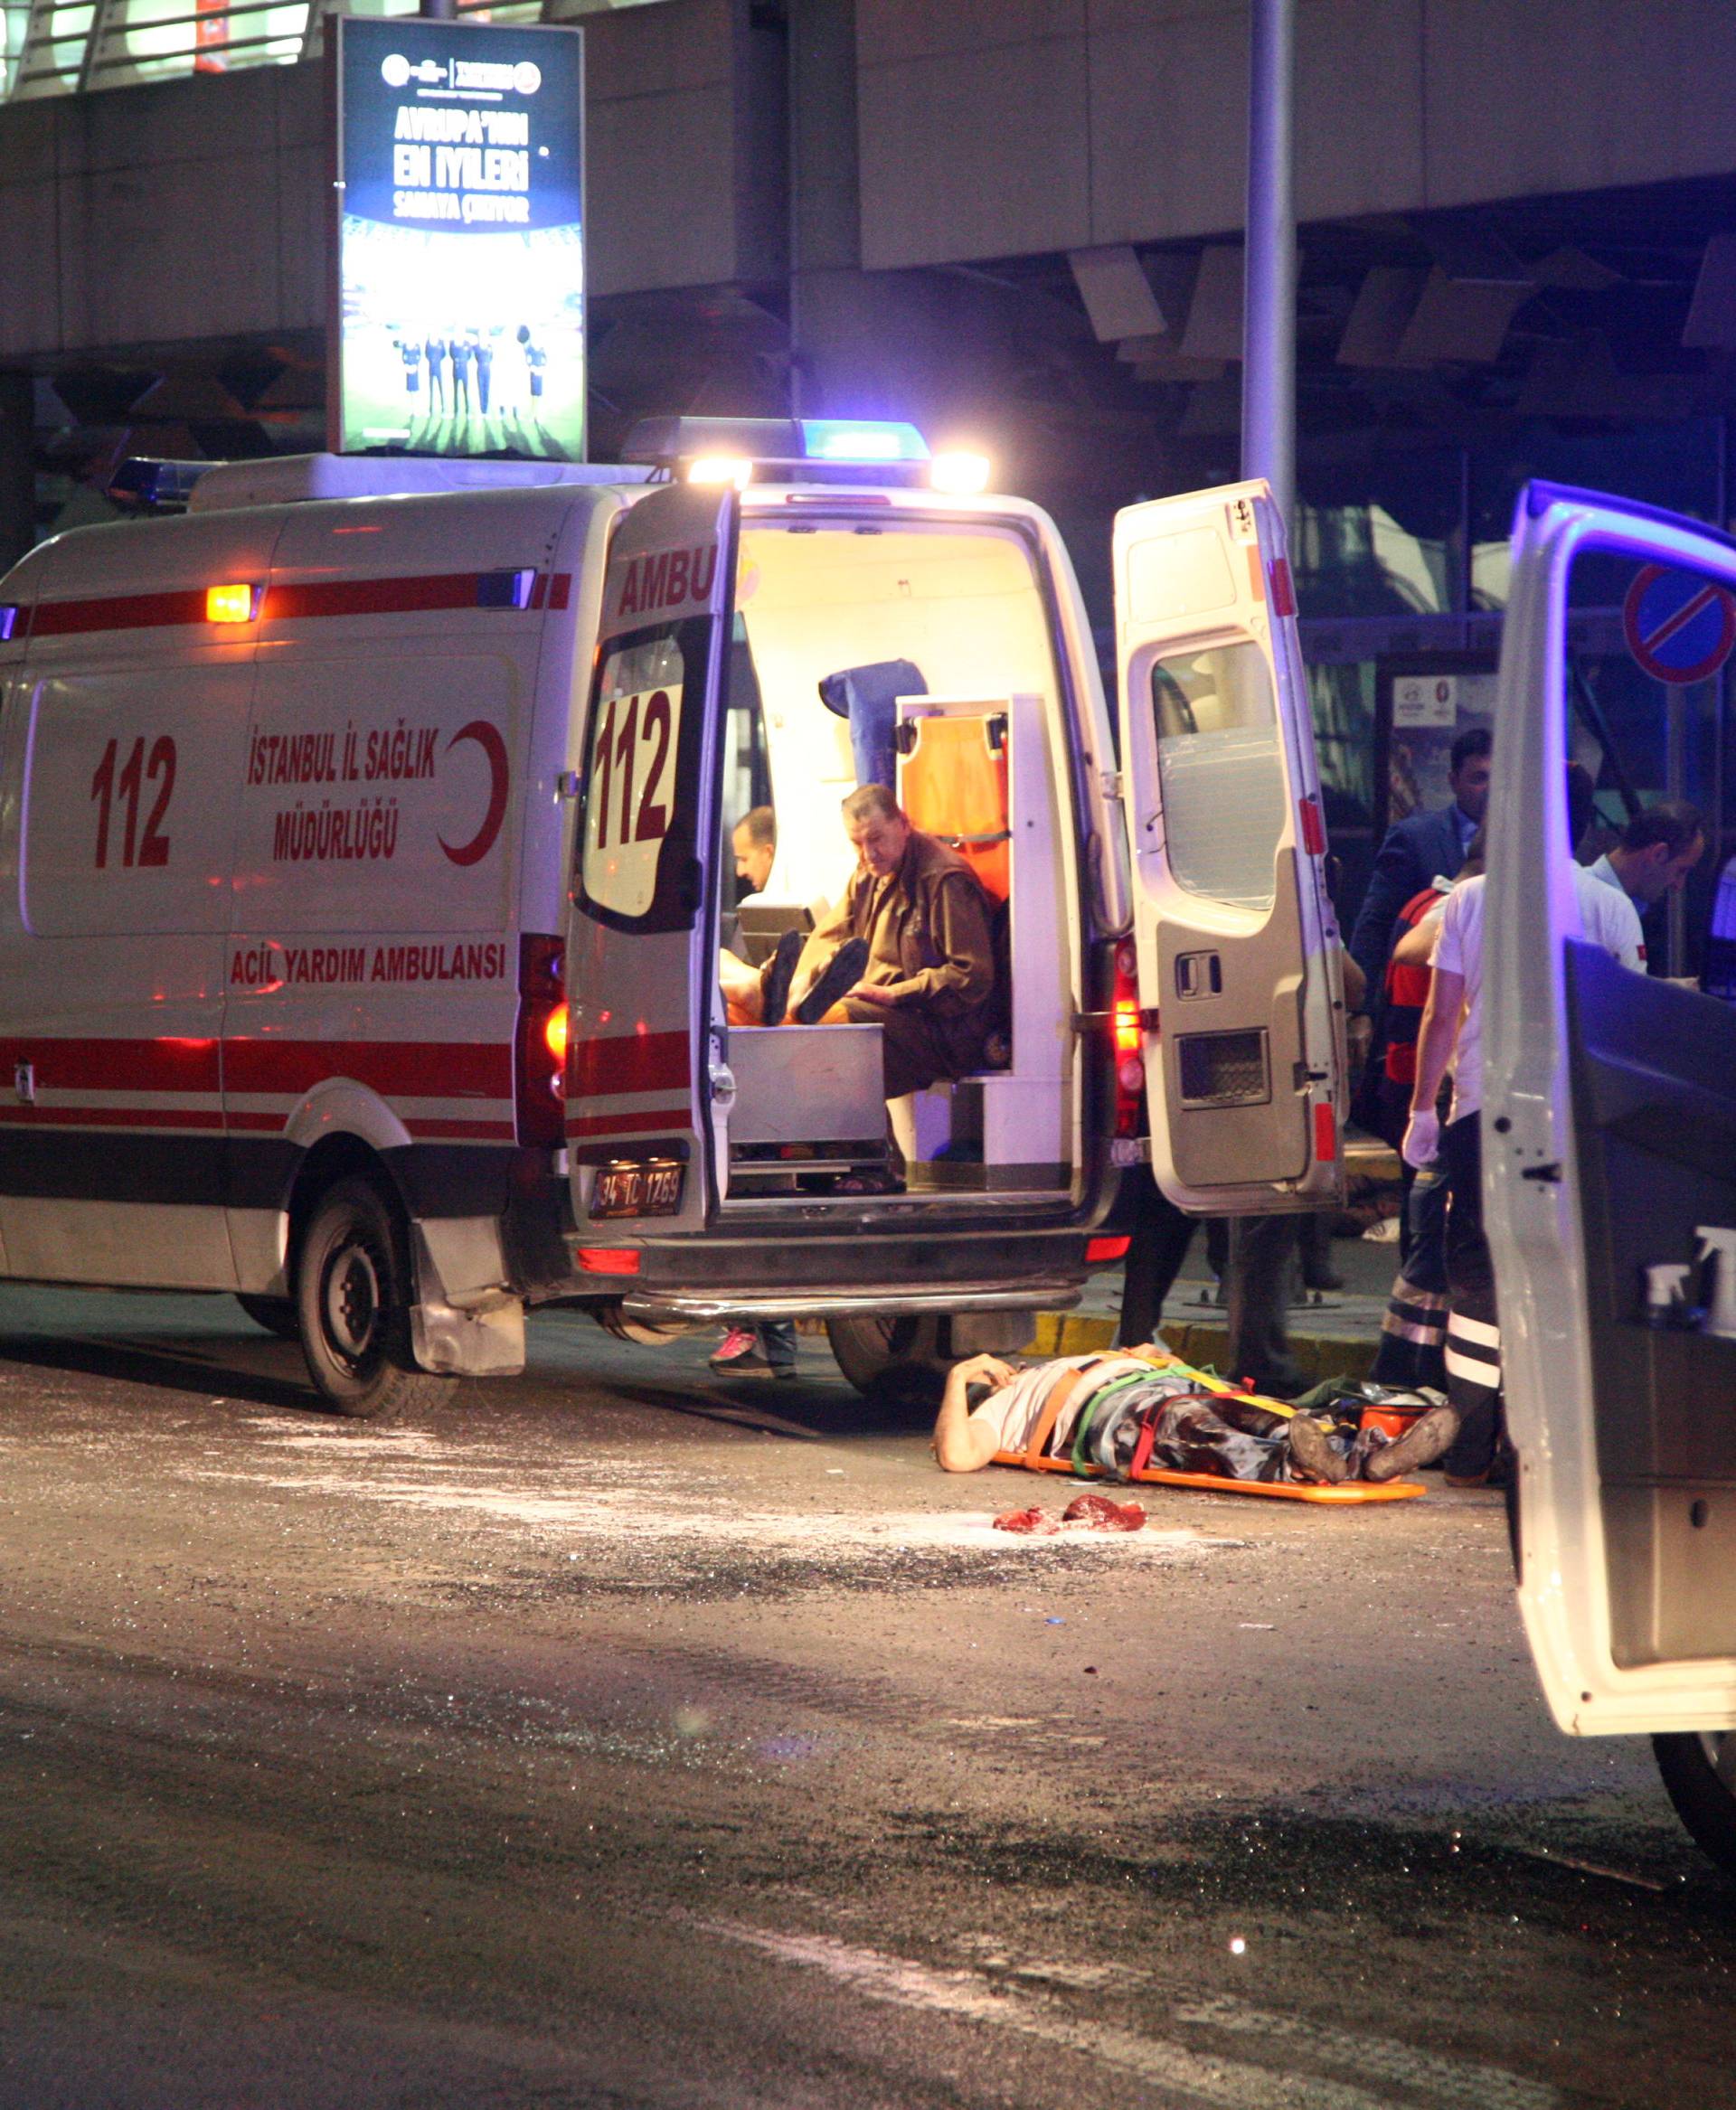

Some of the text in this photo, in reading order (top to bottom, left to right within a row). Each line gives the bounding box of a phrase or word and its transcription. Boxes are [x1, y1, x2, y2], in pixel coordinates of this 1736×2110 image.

[619, 544, 717, 616] AMBU
[248, 718, 439, 785] İSTANBUL İL SAĞLIK
[594, 690, 671, 850] 112
[90, 735, 176, 868] 112
[273, 796, 399, 861] MÜDÜRLÜĞÜ
[284, 945, 364, 984] YARDIM
[372, 943, 506, 983] AMBULANSI
